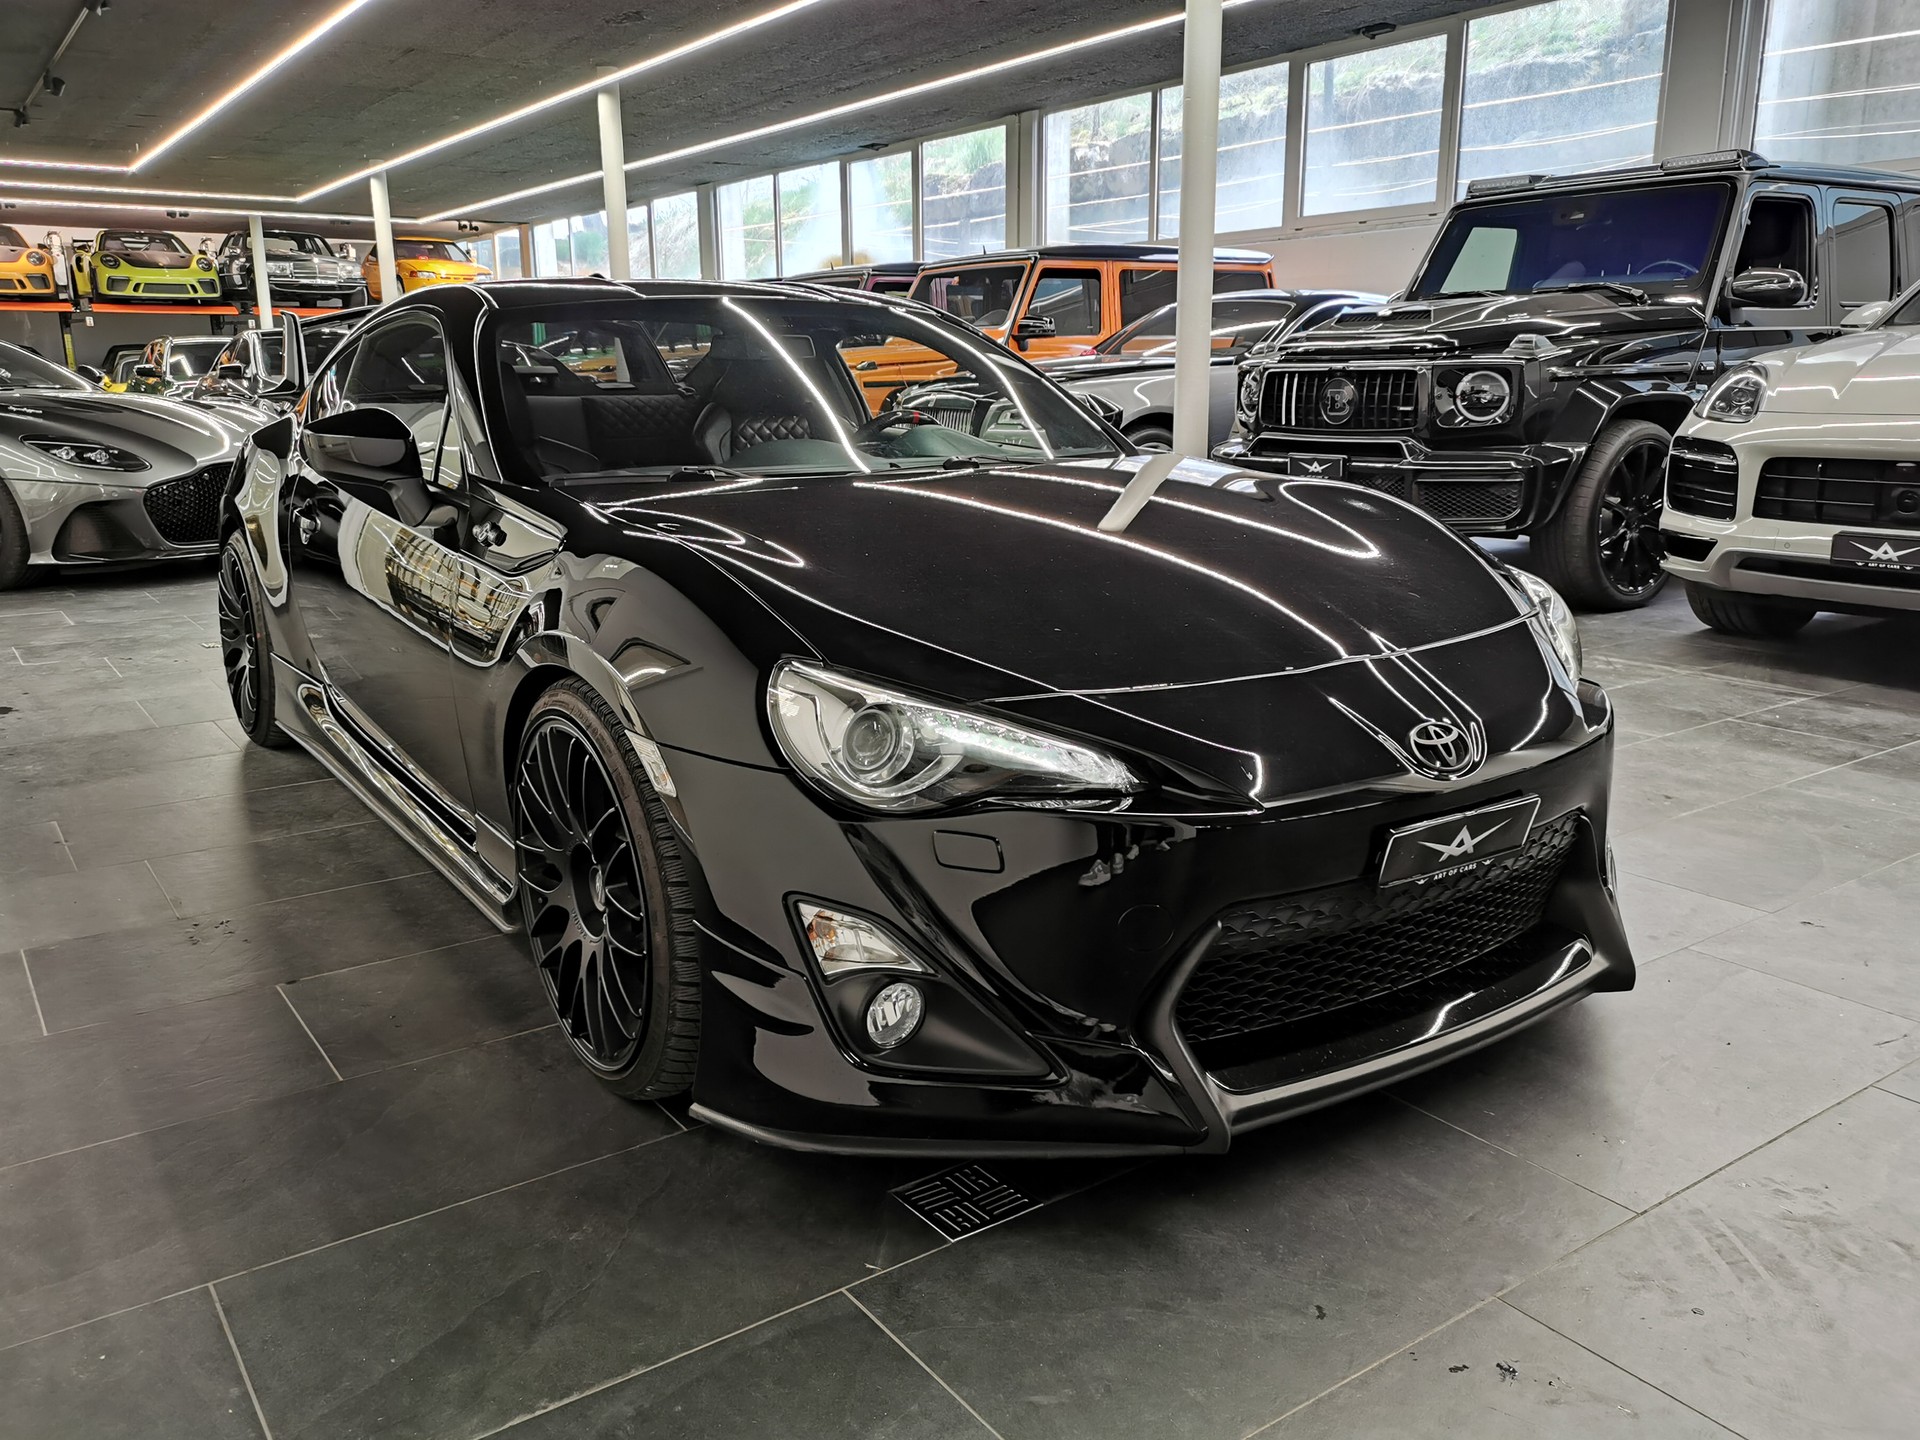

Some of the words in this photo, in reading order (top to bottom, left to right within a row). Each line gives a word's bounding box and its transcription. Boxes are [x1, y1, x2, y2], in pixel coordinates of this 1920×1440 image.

[1433, 872, 1447, 881] ART
[1448, 868, 1458, 876] OF
[1459, 863, 1478, 873] CARS
